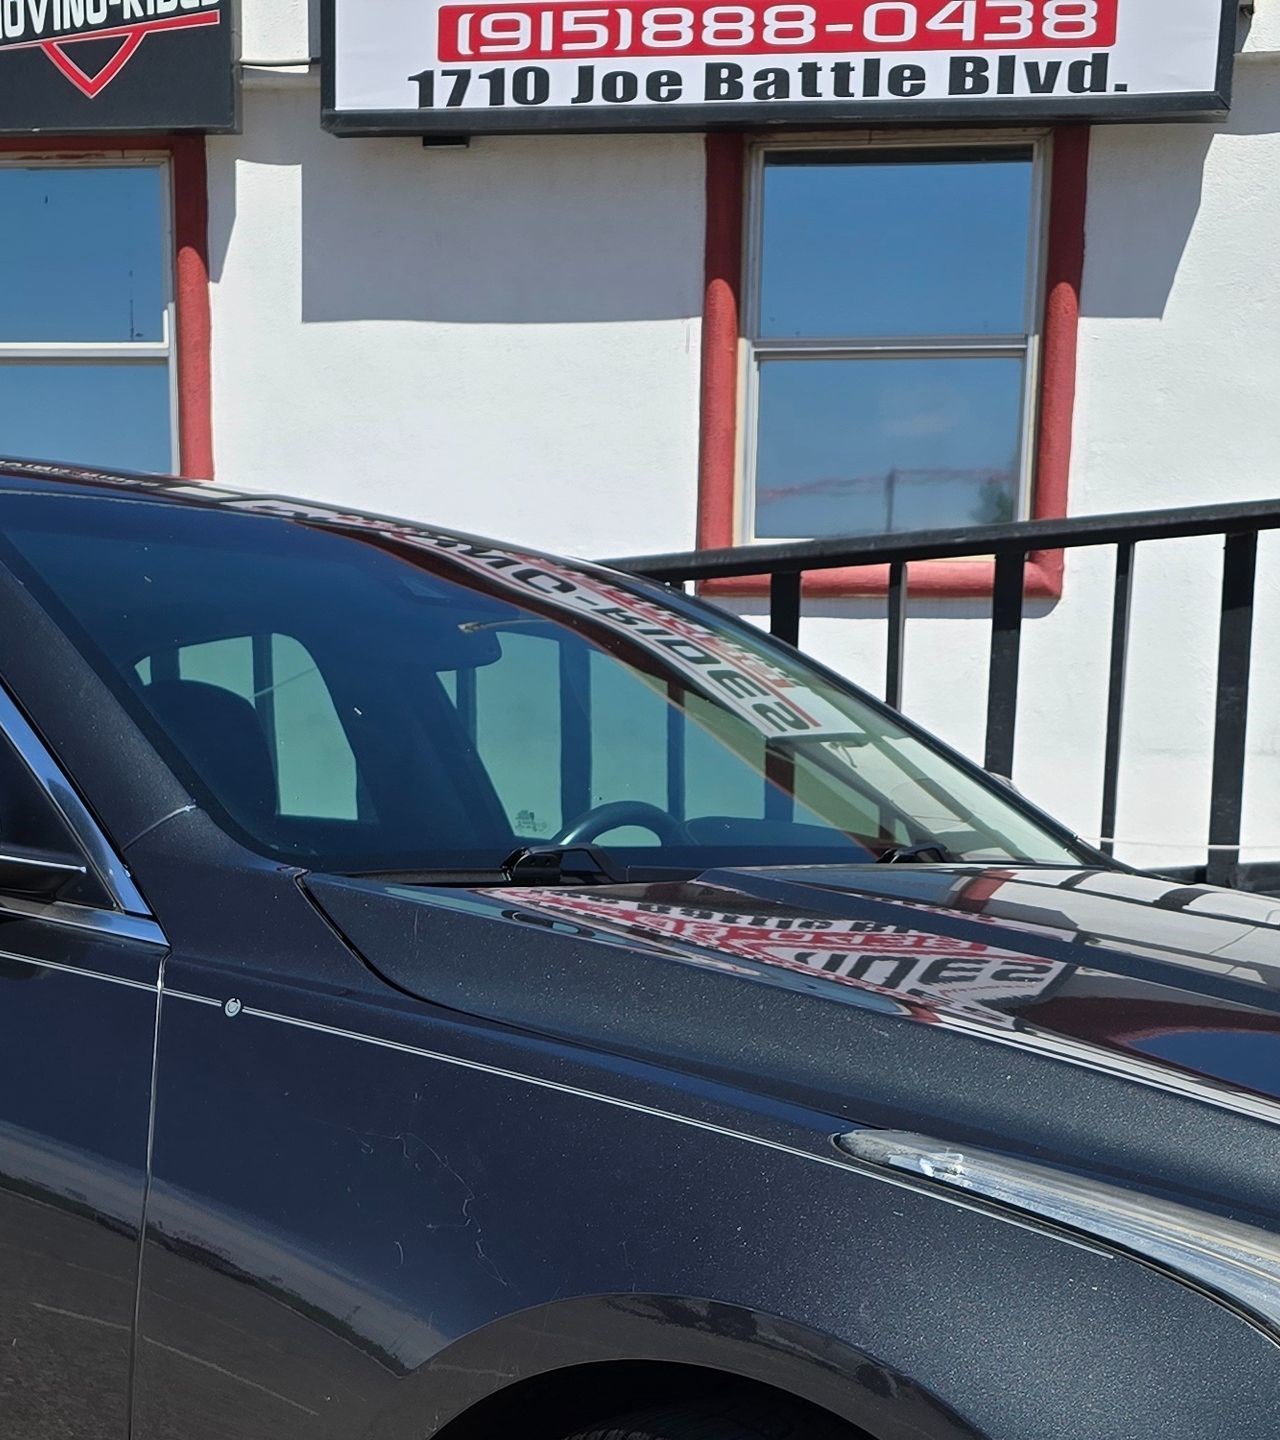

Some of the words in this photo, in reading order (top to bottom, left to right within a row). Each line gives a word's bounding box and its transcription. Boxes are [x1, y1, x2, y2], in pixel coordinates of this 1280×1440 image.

[457, 0, 1098, 56] (915)888-0438
[407, 65, 551, 109] 1710
[570, 64, 683, 105] Joe
[703, 57, 927, 102] Battle
[948, 52, 1129, 97] Blvd.
